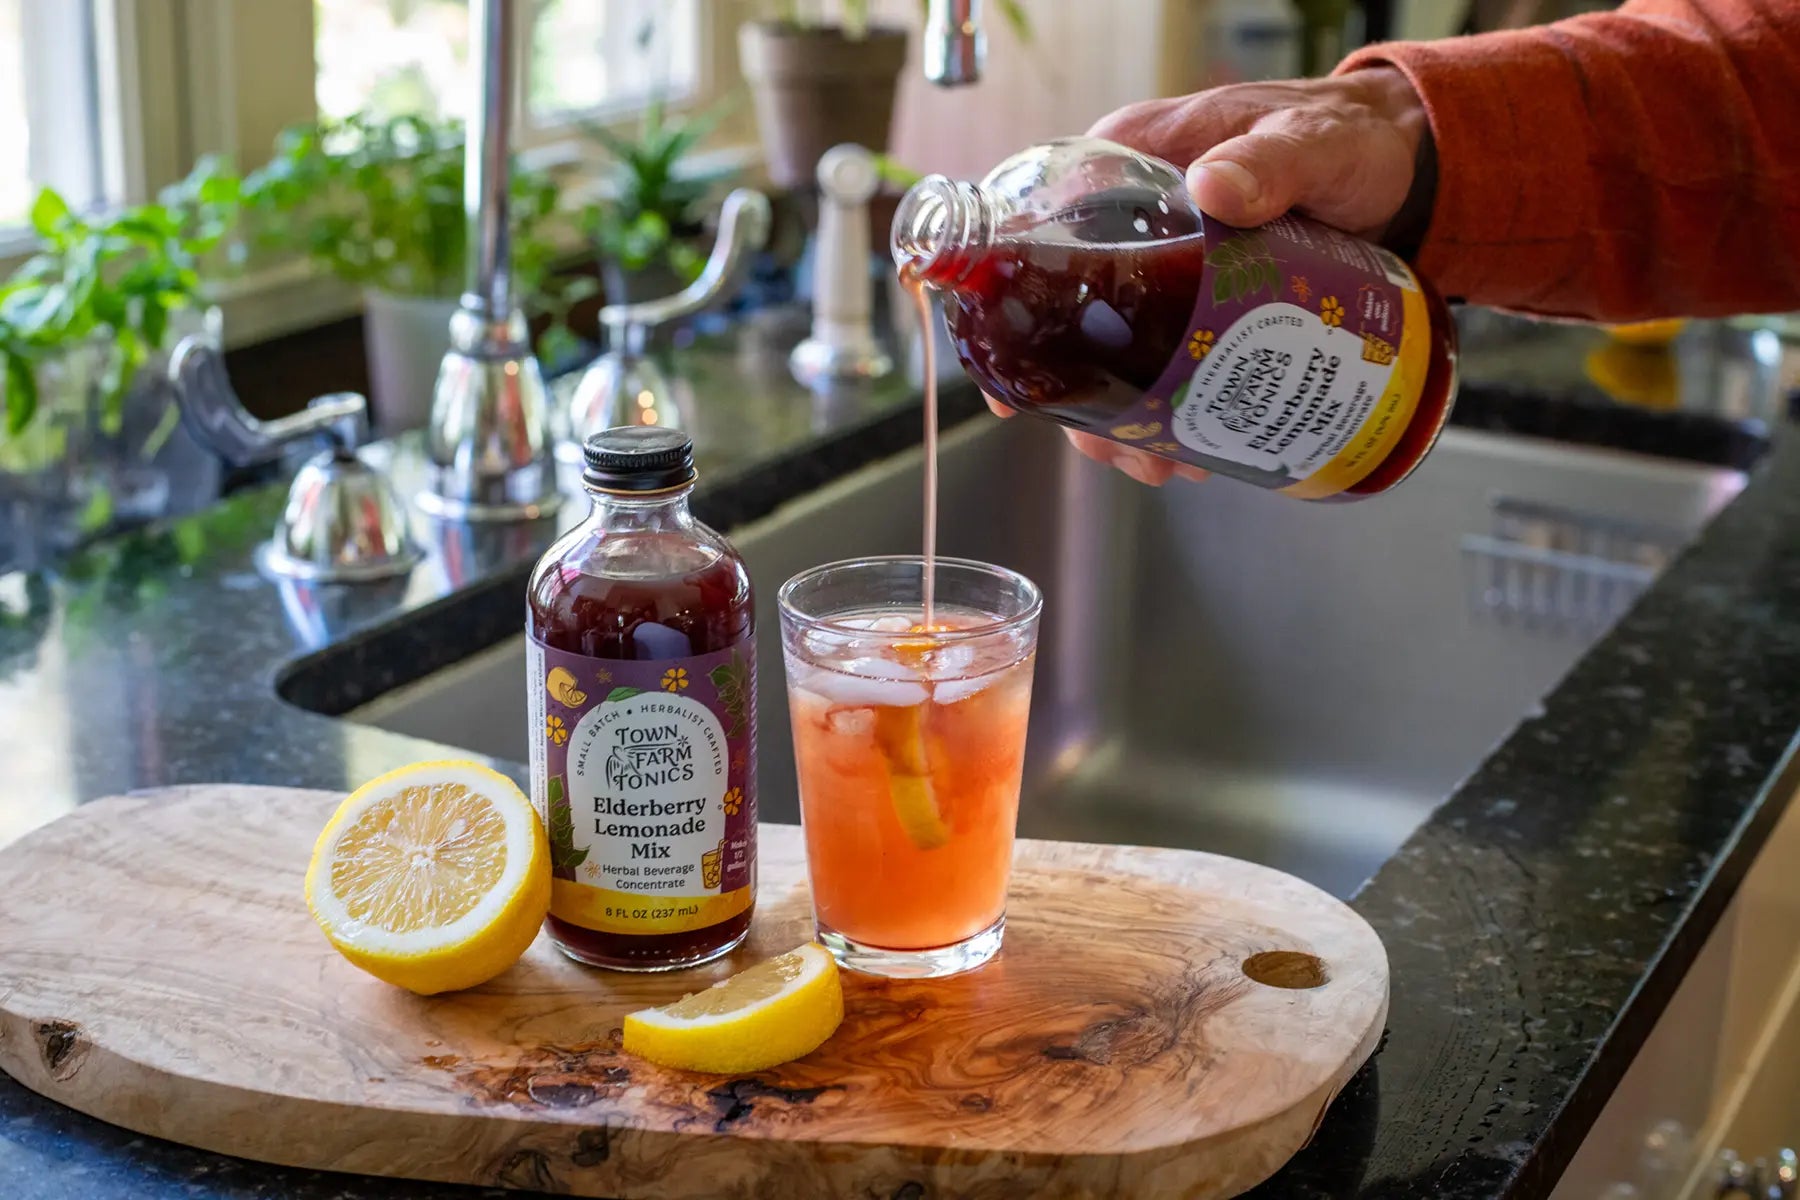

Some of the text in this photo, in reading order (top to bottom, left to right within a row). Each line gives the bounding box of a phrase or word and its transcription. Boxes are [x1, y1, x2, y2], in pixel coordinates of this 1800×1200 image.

[1257, 315, 1304, 329] CRAFTED
[1205, 355, 1249, 414] TOWN
[1239, 348, 1280, 406] FARM
[1243, 351, 1293, 428] TONICS
[1246, 347, 1326, 450] Elderberry
[1265, 355, 1341, 455] Lemonade
[1308, 400, 1343, 435] Mix
[576, 704, 723, 776] SMALL BATCH HERBALIST CRAFTED
[615, 724, 678, 746] TOWN
[636, 745, 692, 769] FARM
[613, 763, 694, 791] TONICS
[593, 797, 707, 816] Elderberry
[594, 817, 706, 838] Lemonade
[631, 843, 671, 859] Mix
[603, 863, 695, 876] Herbal Beverage
[615, 878, 685, 890] Concentrate
[605, 904, 699, 919] 8 FL OZ (237 mL)
